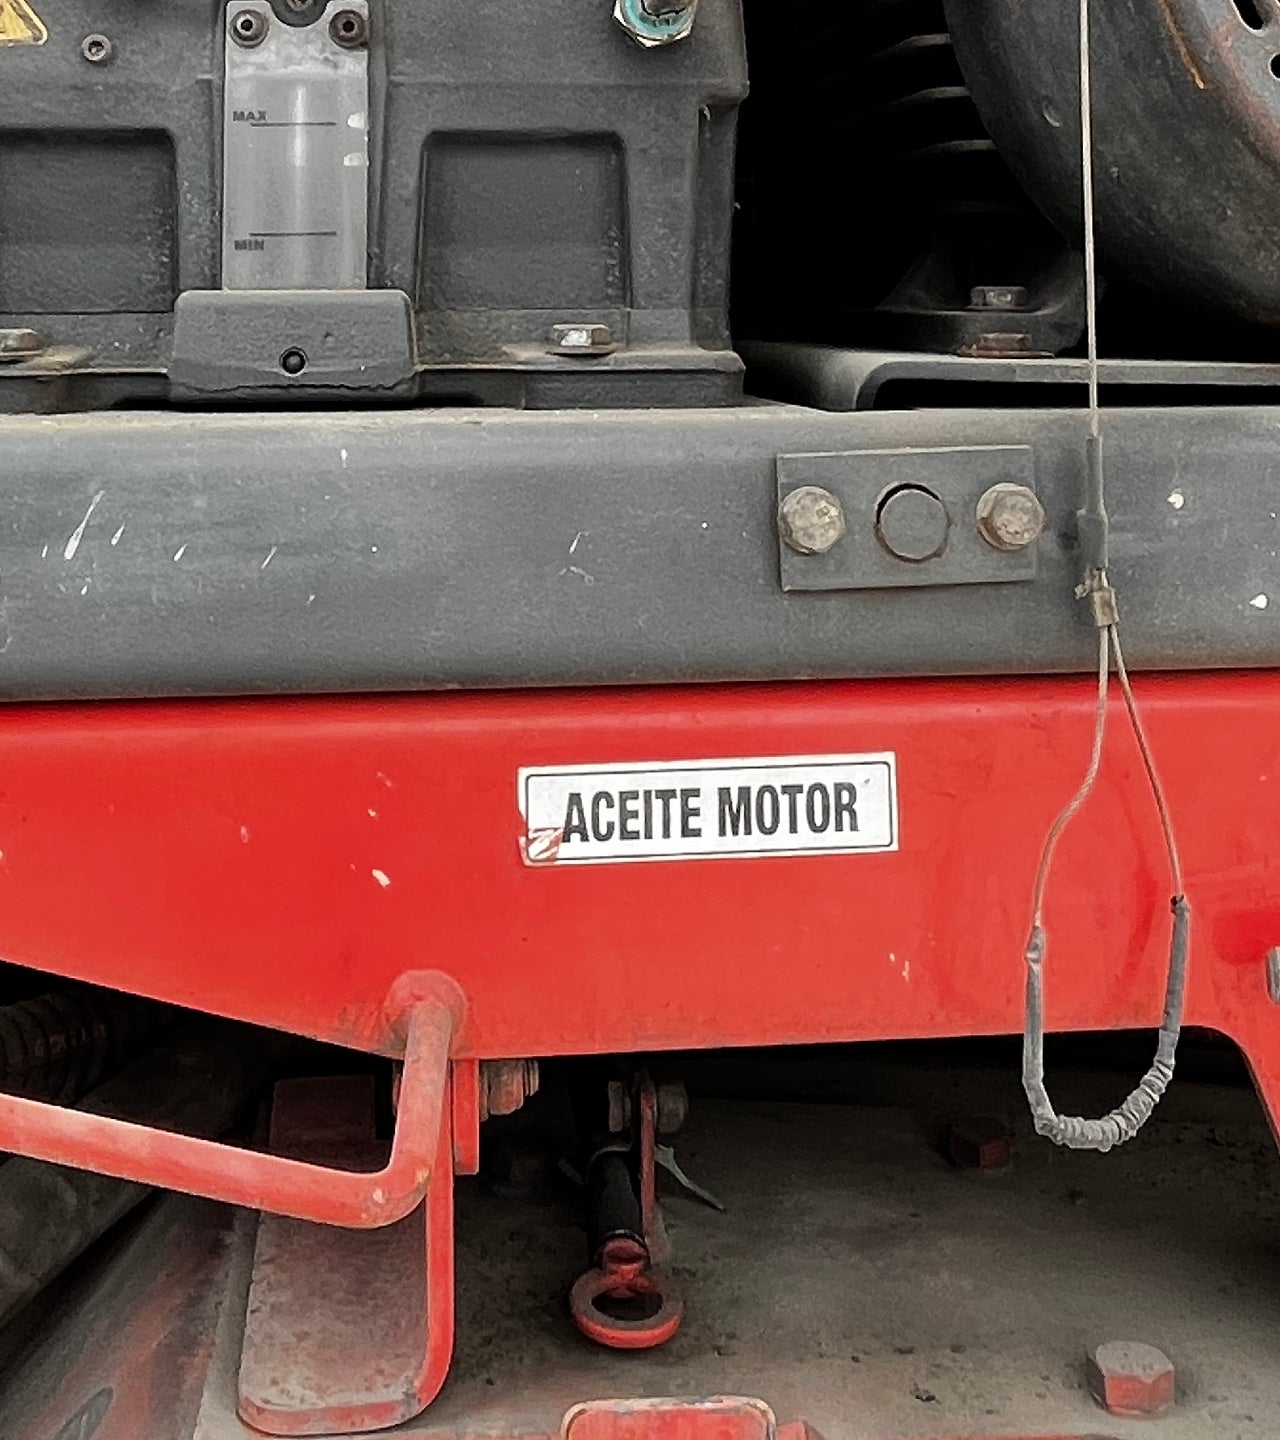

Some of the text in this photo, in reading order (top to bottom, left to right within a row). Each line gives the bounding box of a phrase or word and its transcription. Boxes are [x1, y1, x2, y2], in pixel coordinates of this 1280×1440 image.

[232, 110, 267, 121] MAX
[234, 239, 264, 251] MIN
[563, 782, 859, 842] ACEITE MOTOR
